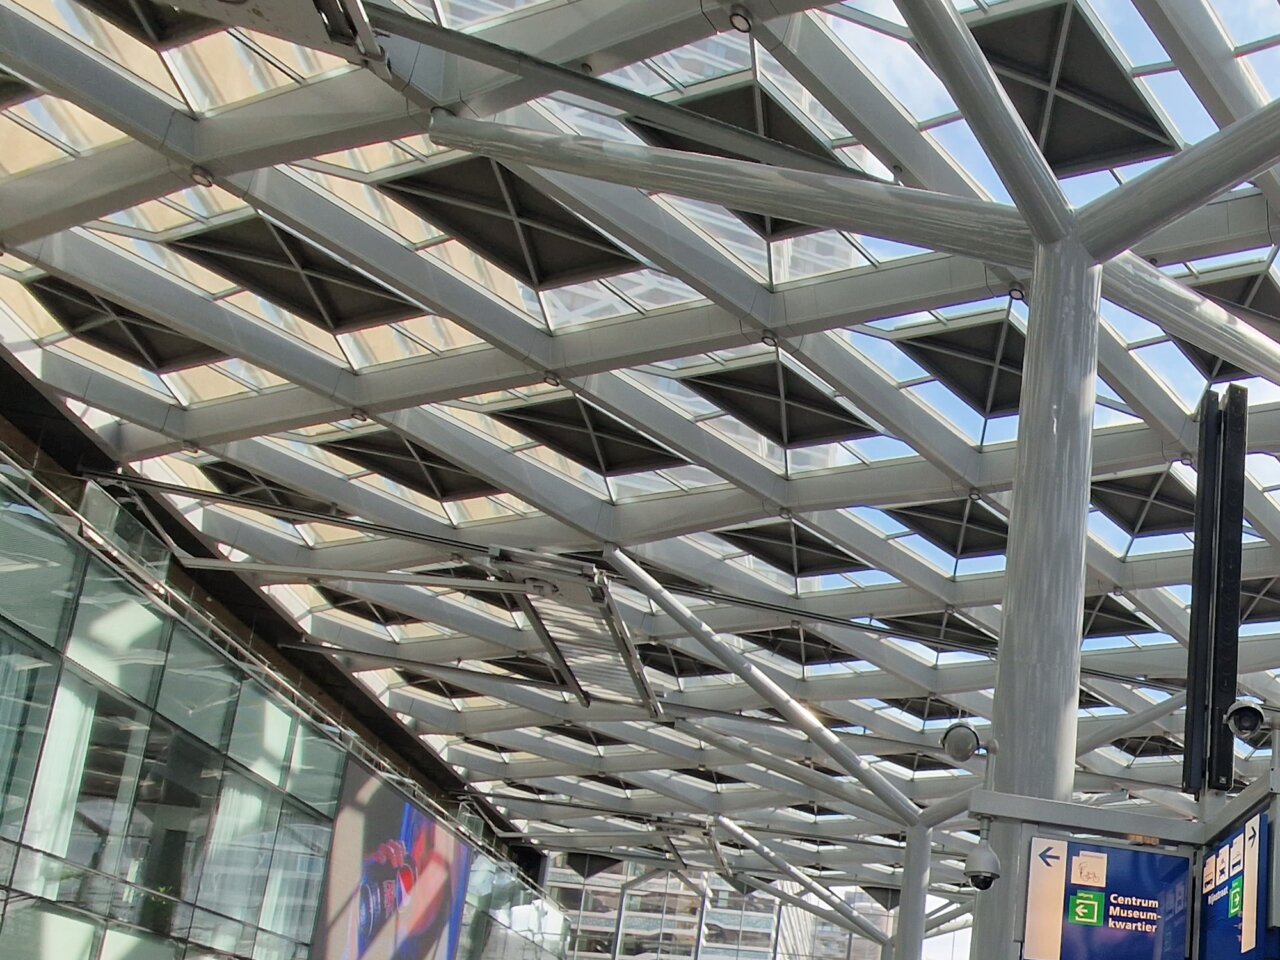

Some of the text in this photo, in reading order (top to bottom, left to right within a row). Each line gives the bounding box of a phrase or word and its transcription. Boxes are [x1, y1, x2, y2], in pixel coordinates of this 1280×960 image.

[1109, 893, 1159, 908] Centrum
[1109, 906, 1162, 920] Museum-
[1108, 918, 1158, 932] kwartier
